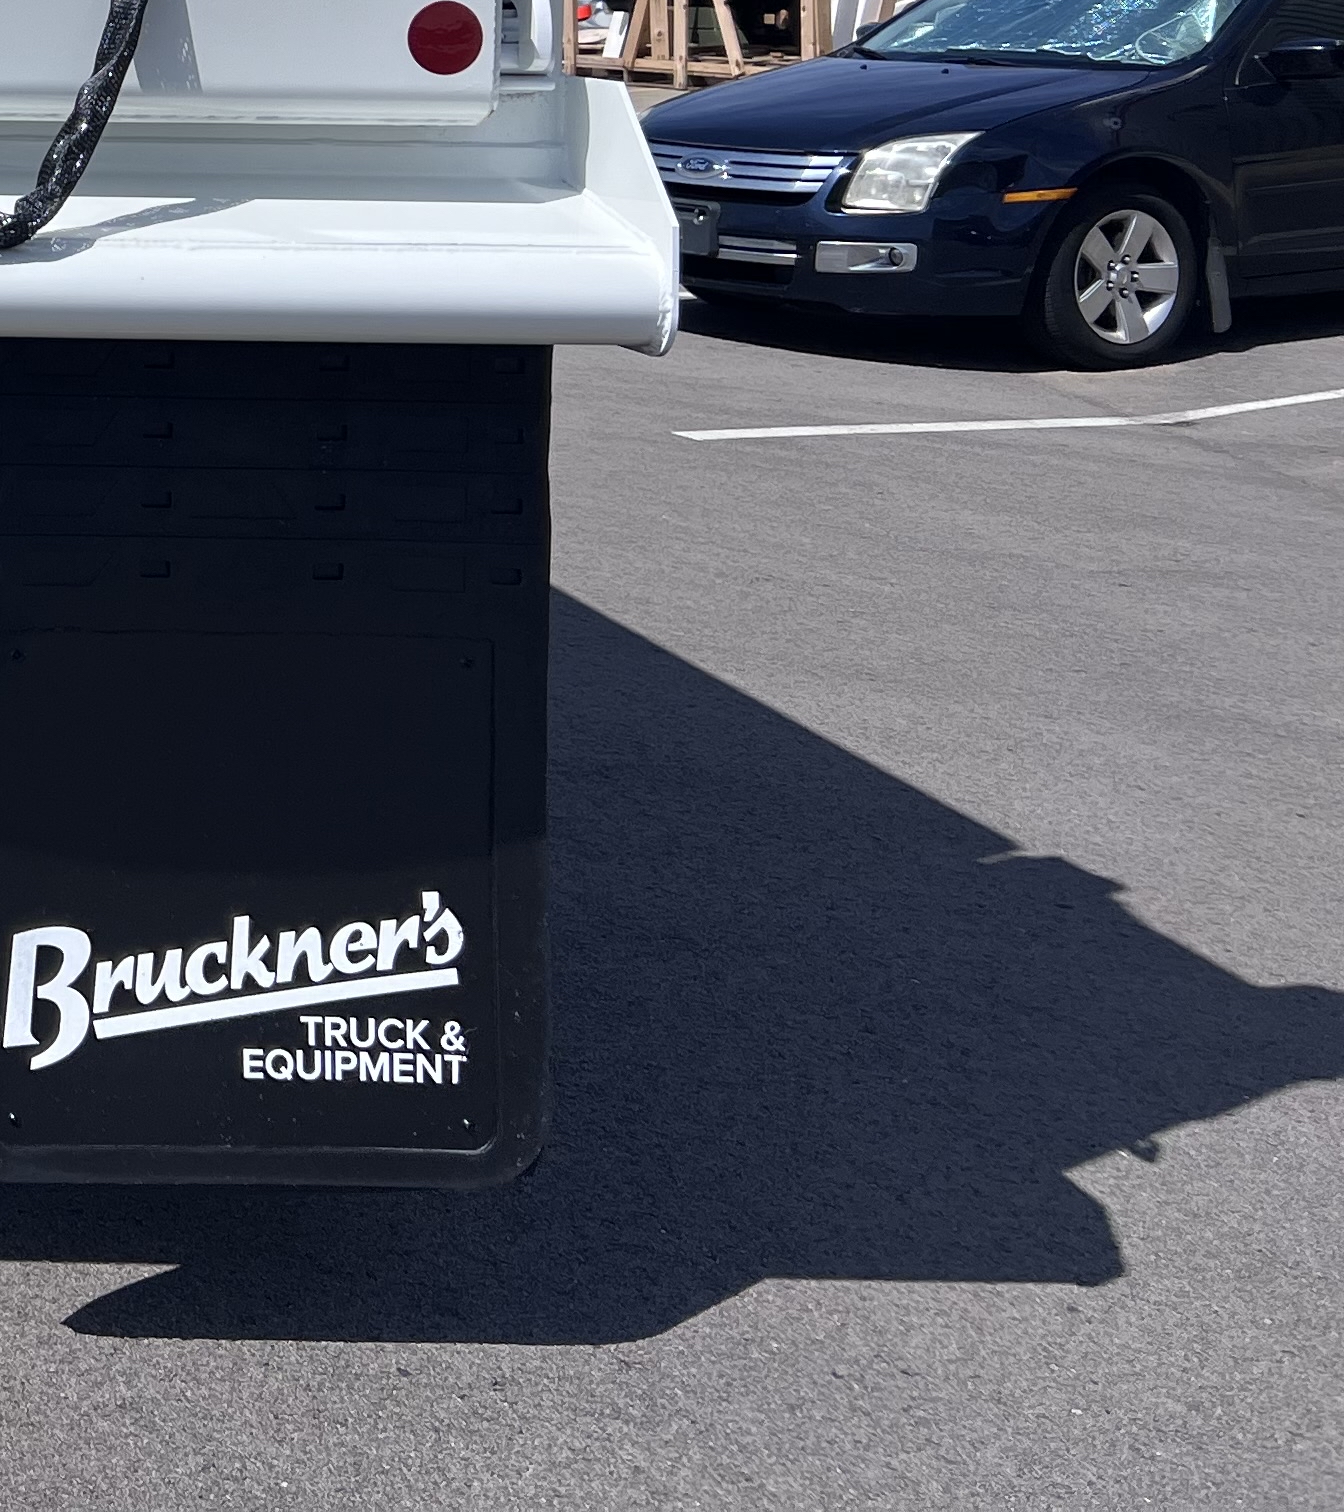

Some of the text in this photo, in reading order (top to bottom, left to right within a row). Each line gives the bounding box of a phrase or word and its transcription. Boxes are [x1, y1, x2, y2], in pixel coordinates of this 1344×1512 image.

[3, 891, 464, 1070] Bruckner's
[299, 1015, 467, 1051] TRUCK &
[242, 1049, 467, 1085] EQUIPMENT
